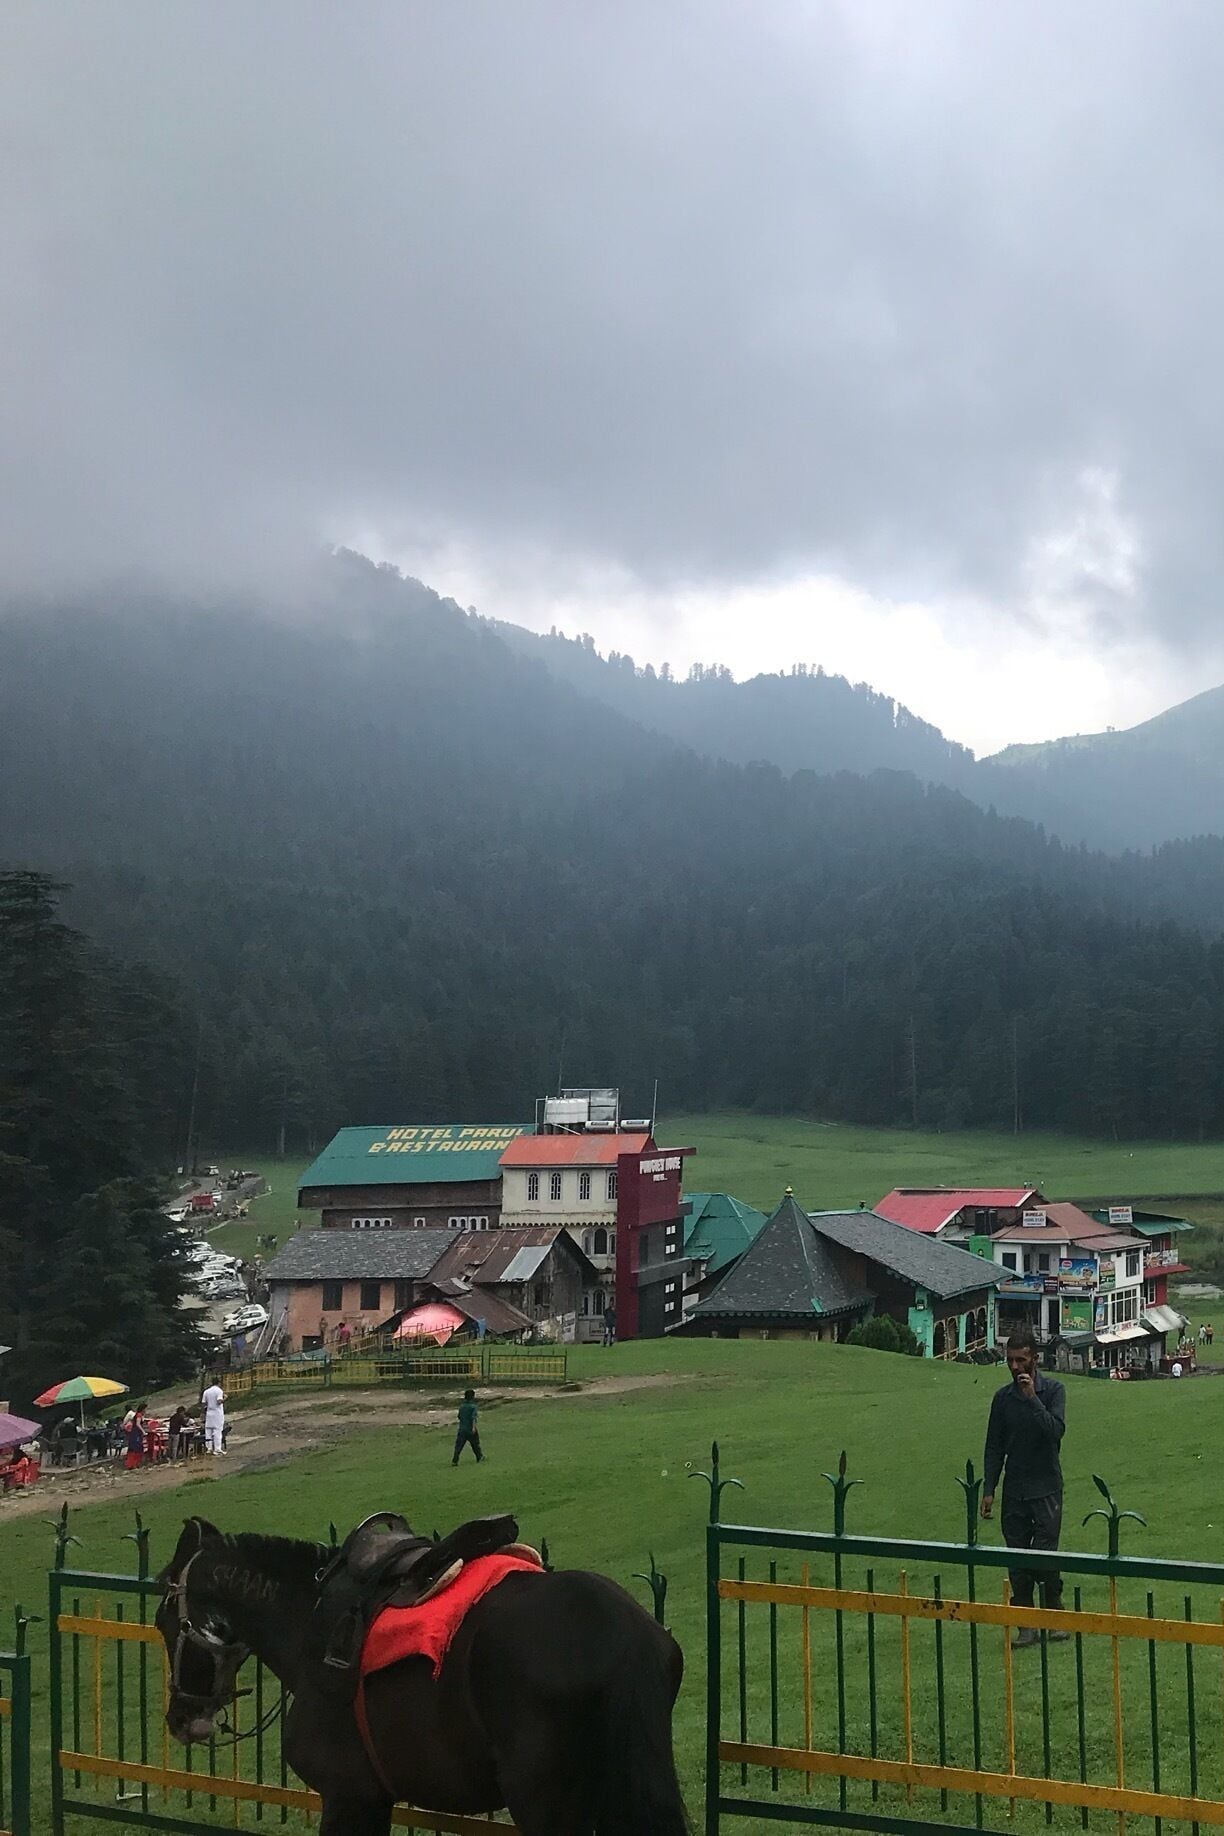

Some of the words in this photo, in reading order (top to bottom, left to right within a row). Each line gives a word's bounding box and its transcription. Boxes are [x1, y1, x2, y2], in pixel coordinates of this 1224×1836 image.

[386, 1128, 453, 1140] HOTEL
[459, 1127, 525, 1138] PARUL
[385, 1140, 511, 1153] RESTAURAN
